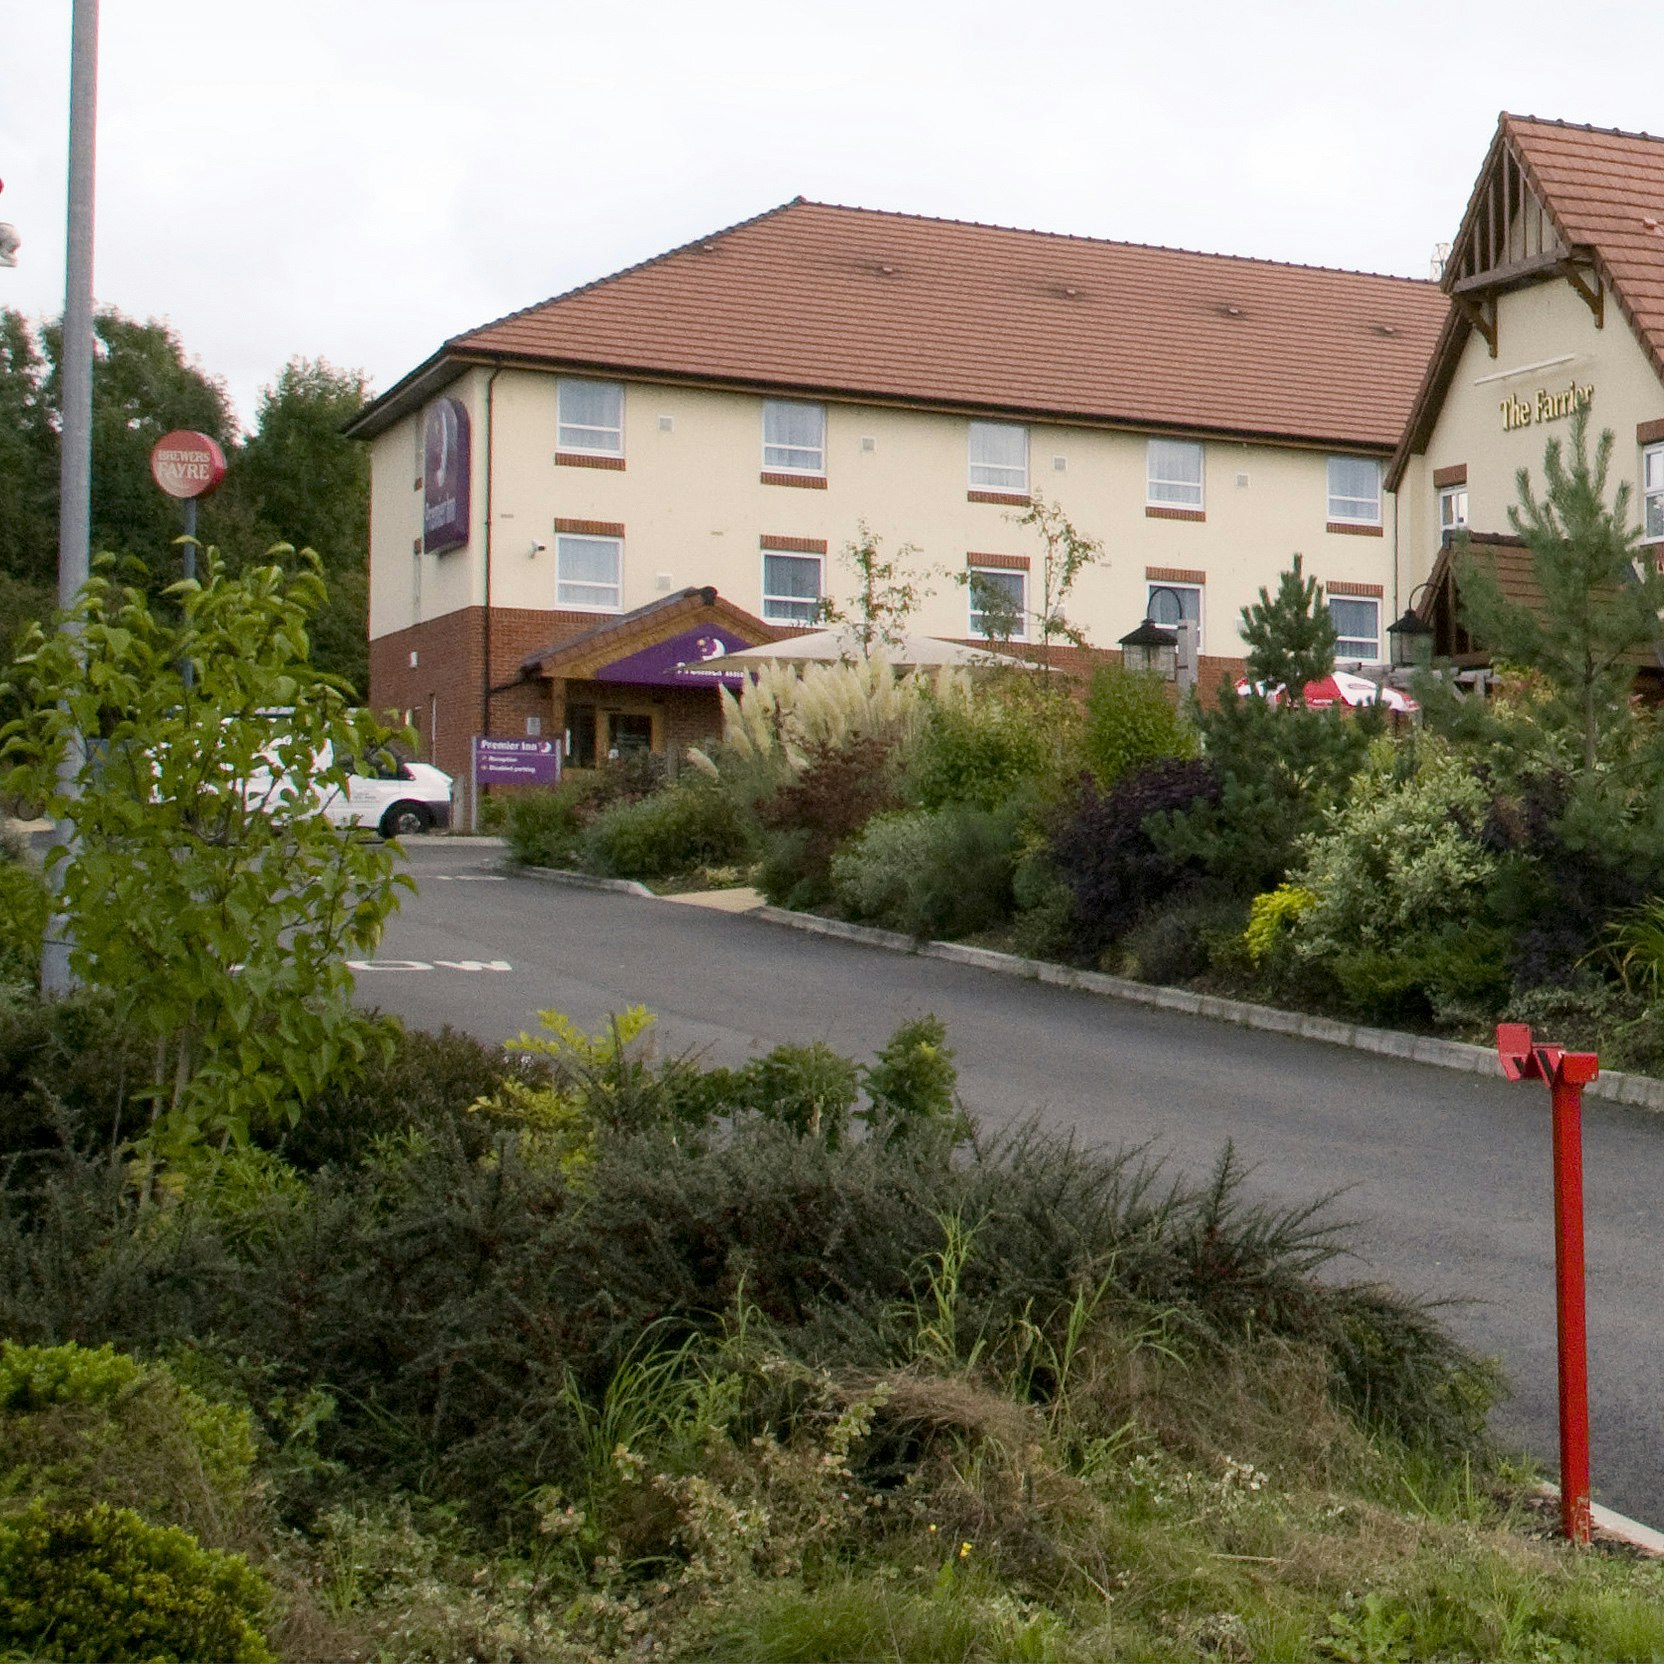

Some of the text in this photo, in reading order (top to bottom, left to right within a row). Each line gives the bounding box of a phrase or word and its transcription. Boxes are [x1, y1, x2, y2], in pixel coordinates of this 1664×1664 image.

[1500, 392, 1532, 432] The
[157, 449, 210, 463] BREWERS
[157, 462, 210, 480] FAYRE
[480, 739, 538, 751] Premier Inn
